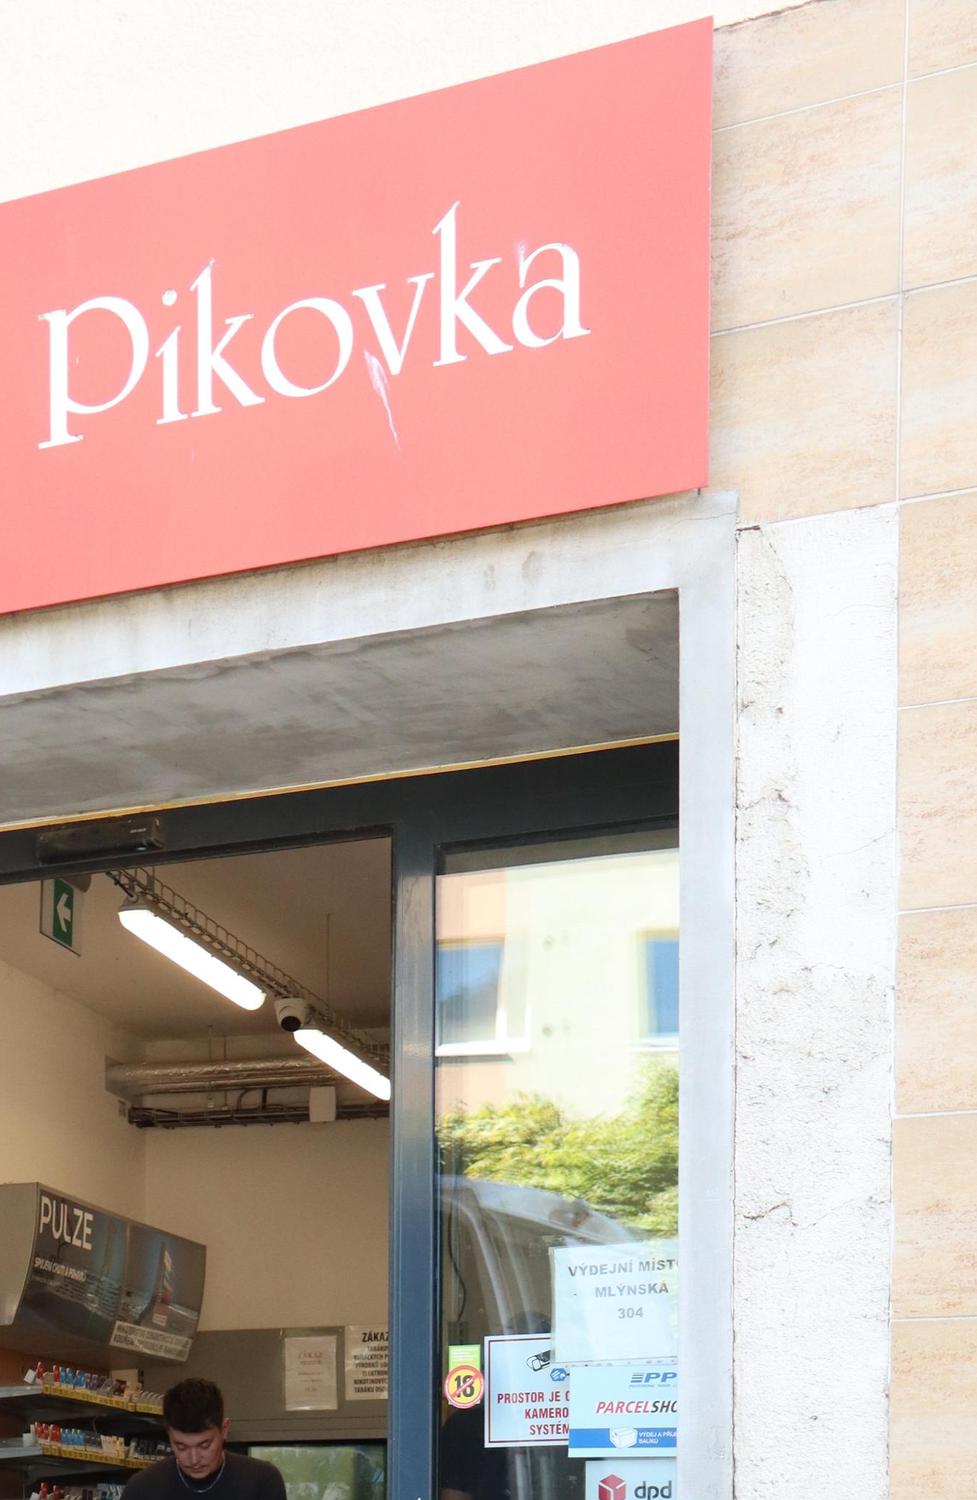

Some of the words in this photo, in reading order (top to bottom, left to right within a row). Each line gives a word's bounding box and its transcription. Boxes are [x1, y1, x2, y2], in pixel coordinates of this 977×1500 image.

[37, 201, 592, 450] Pikovka
[39, 1196, 94, 1251] PULZE
[567, 1259, 633, 1277] VÝDEJNÍ
[594, 1280, 669, 1298] MLÝNSKÁ
[616, 1306, 644, 1319] 304
[454, 1374, 475, 1398] 18
[497, 1391, 544, 1404] PROSTOR
[549, 1390, 561, 1402] JE
[525, 1406, 569, 1419] KAMERO
